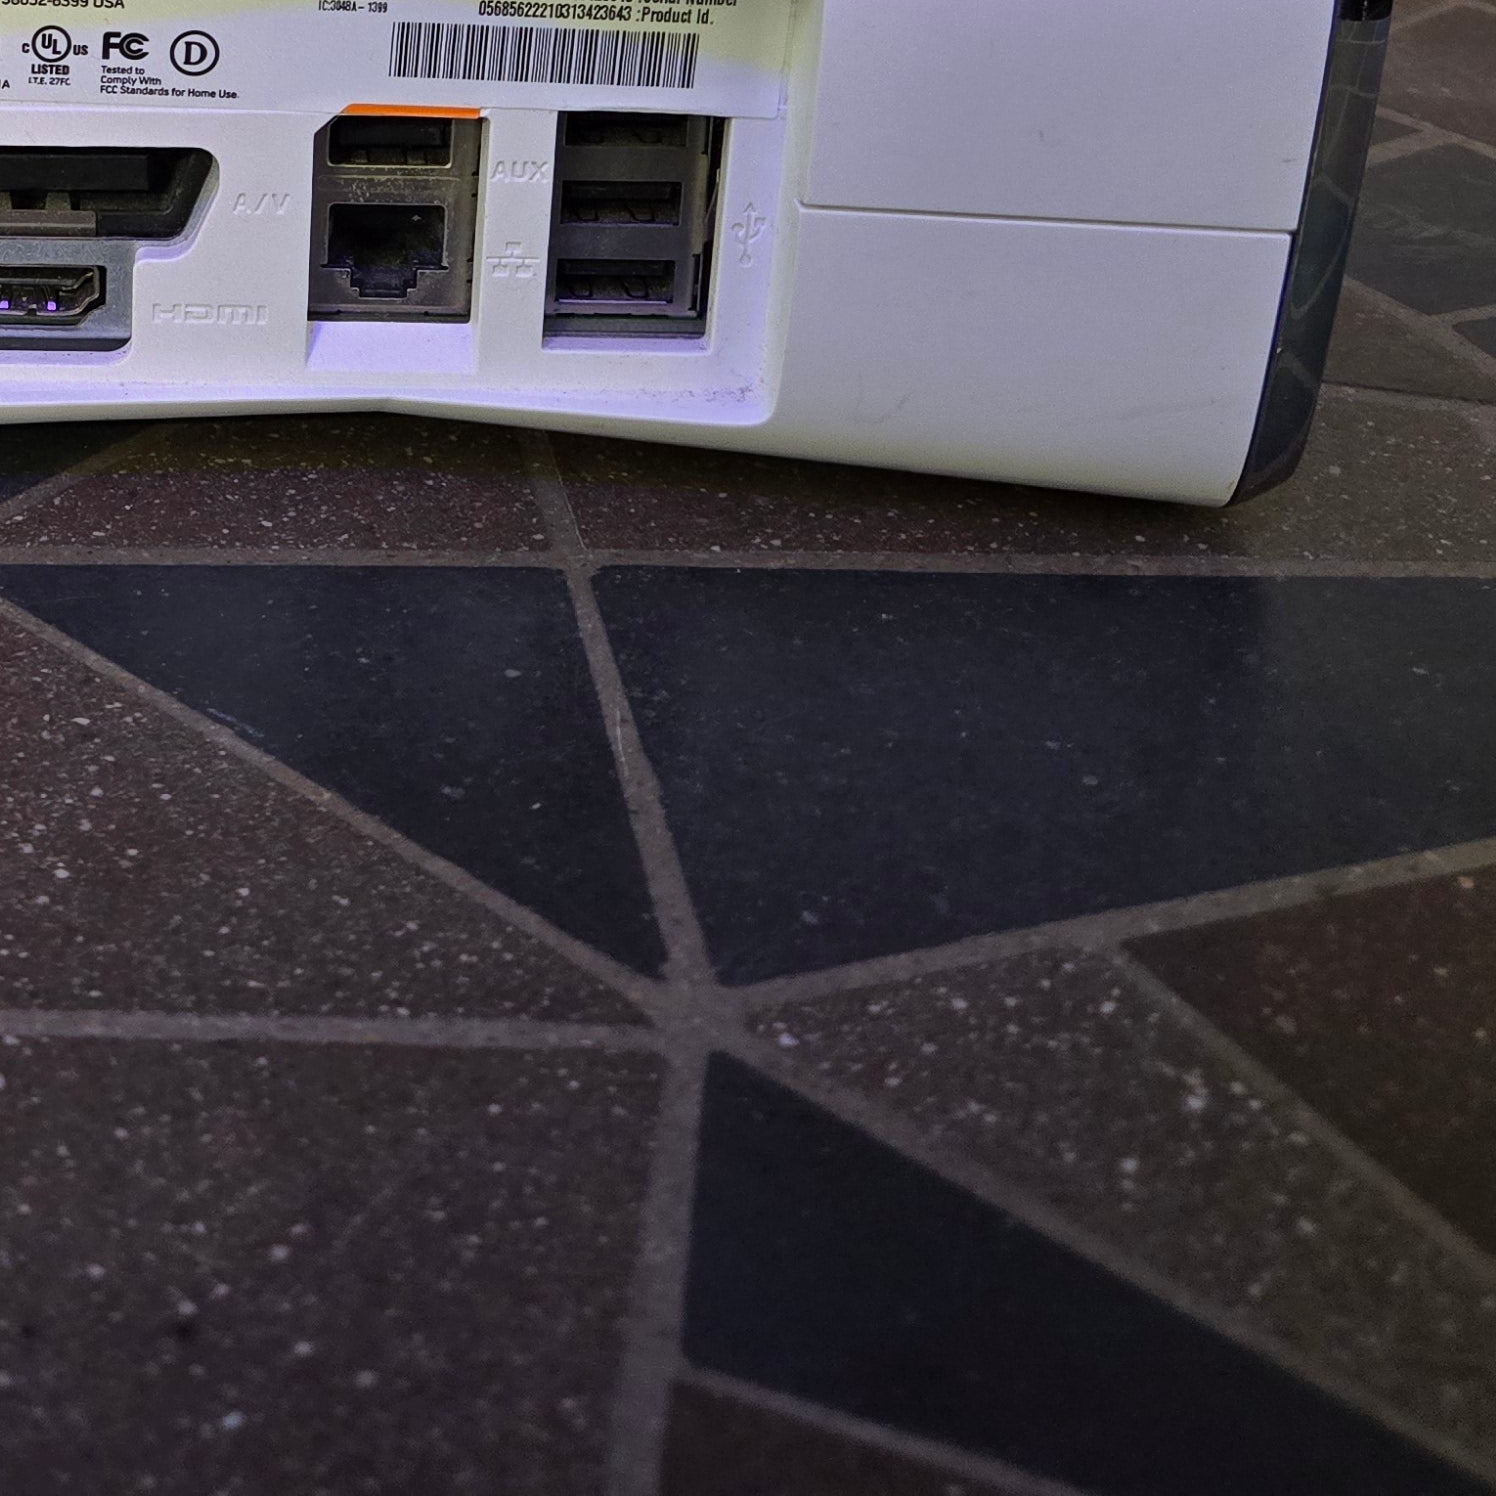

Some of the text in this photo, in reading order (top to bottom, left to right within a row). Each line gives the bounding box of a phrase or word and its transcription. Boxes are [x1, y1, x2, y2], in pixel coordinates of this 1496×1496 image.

[635, 6, 692, 24] :Product
[696, 8, 714, 25] Id.
[41, 33, 62, 56] UL
[183, 40, 208, 66] D
[30, 63, 71, 76] LISTED
[101, 65, 145, 75] Tested to
[100, 75, 162, 86] Comply With
[100, 85, 118, 94] FCC
[119, 86, 169, 97] Standards
[171, 88, 186, 97] for
[187, 88, 216, 98] Home
[490, 160, 549, 182] AUX
[233, 192, 291, 215] A/V
[152, 303, 269, 325] HDMI
